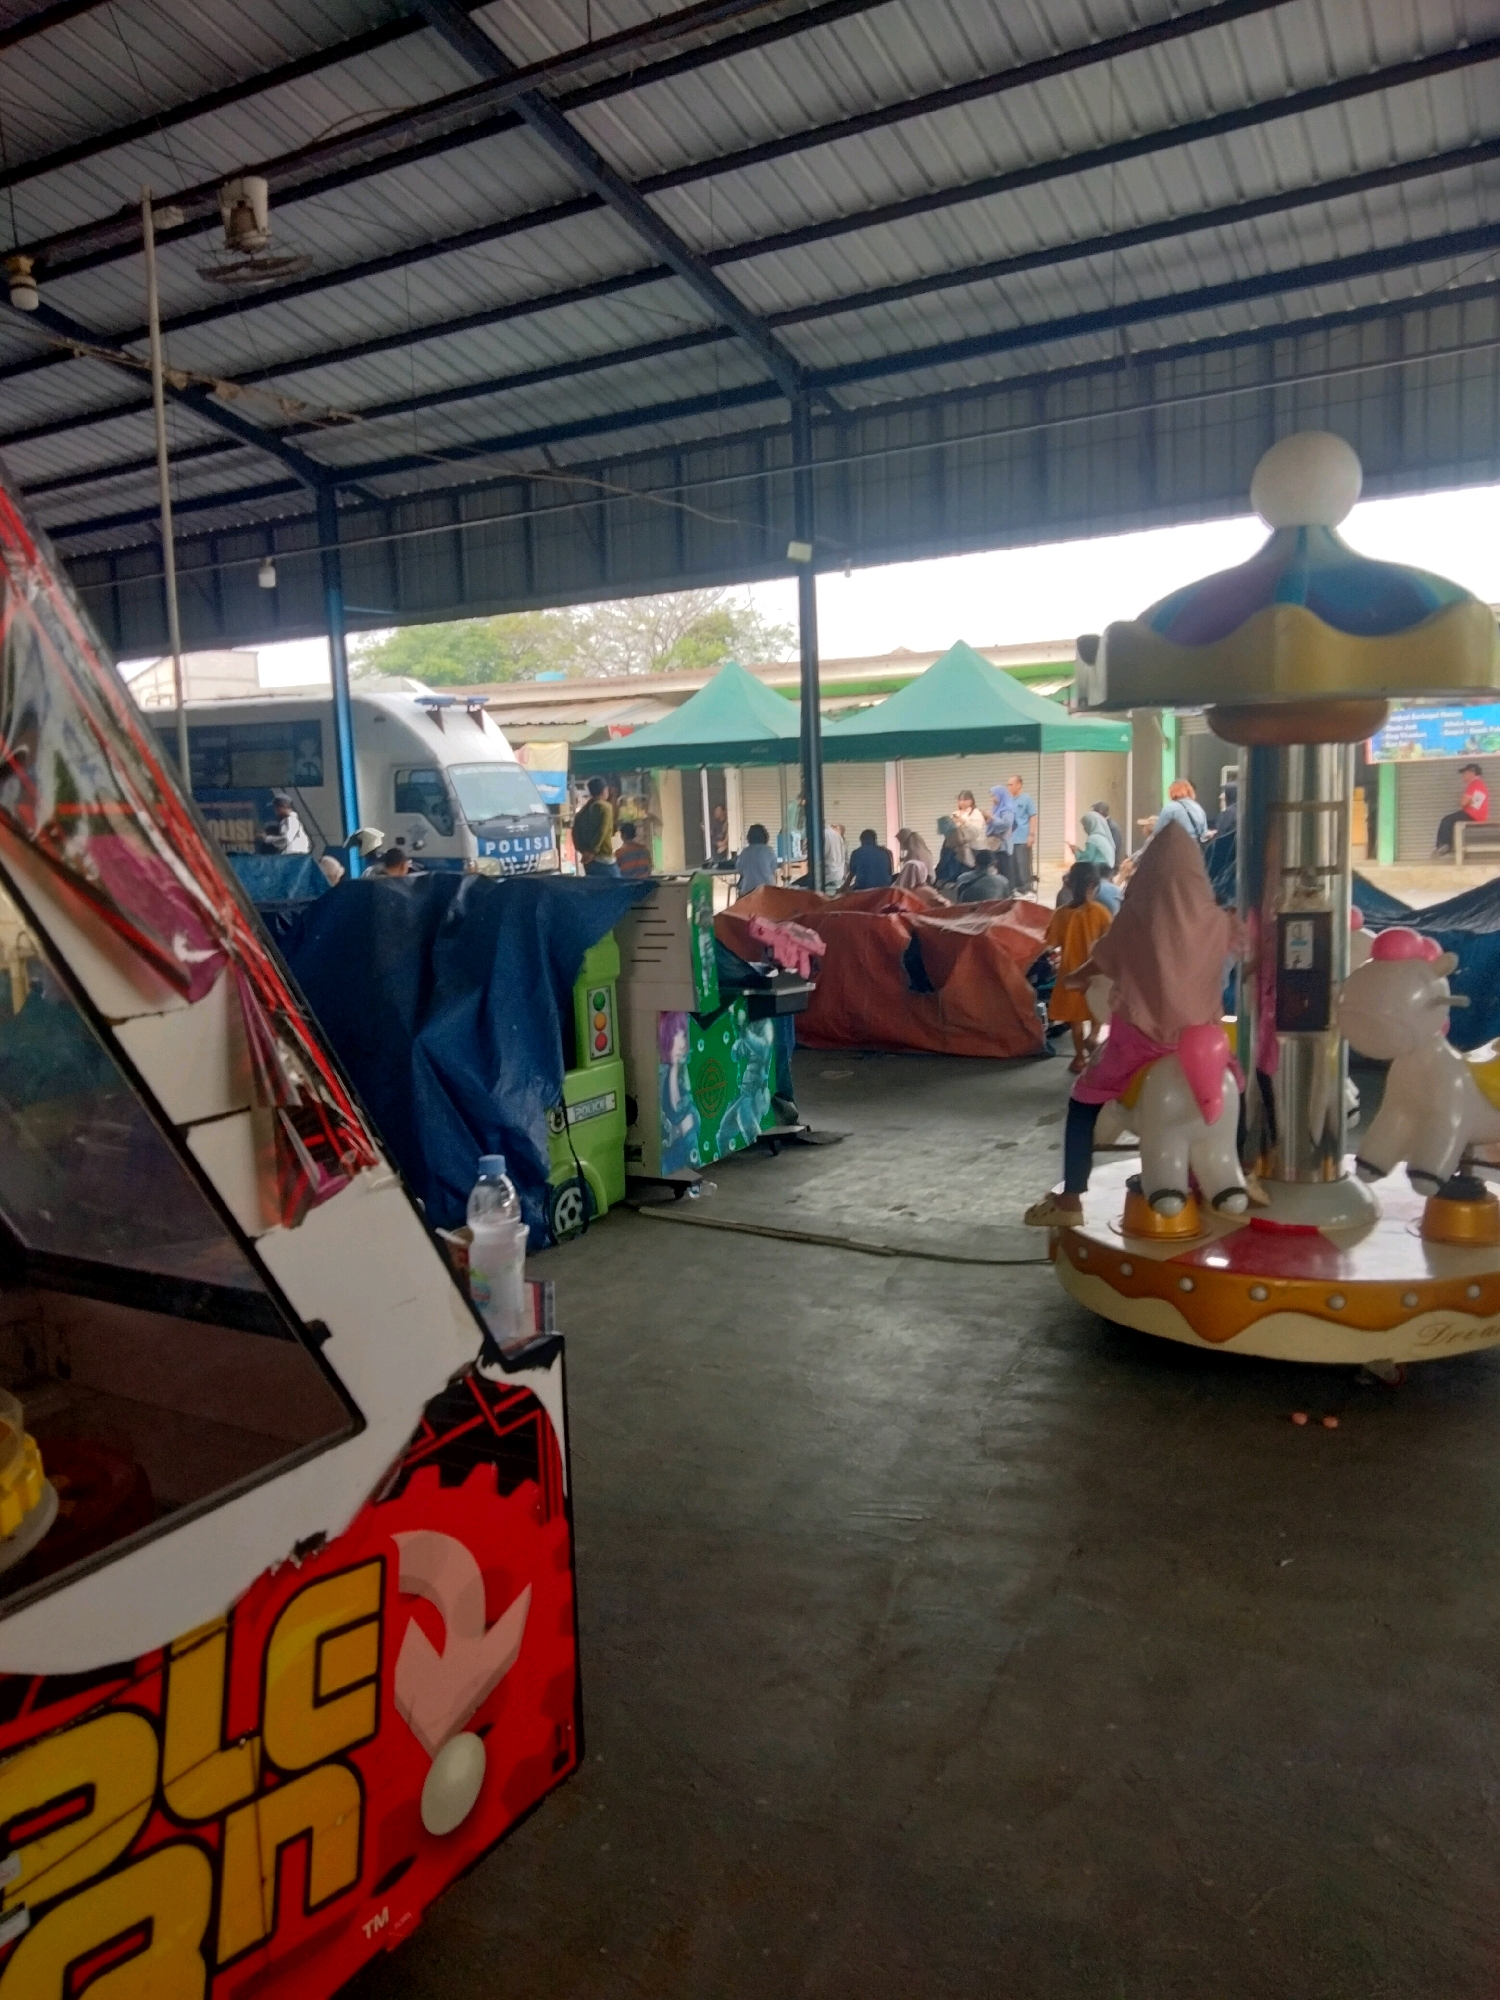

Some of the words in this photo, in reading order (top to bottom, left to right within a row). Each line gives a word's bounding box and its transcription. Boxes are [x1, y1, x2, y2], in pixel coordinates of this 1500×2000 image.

[207, 819, 254, 841] OLISI
[486, 836, 549, 855] POLISI
[575, 1099, 606, 1117] POLICE
[1413, 1322, 1500, 1347] Drea
[361, 1905, 389, 1940] TM
